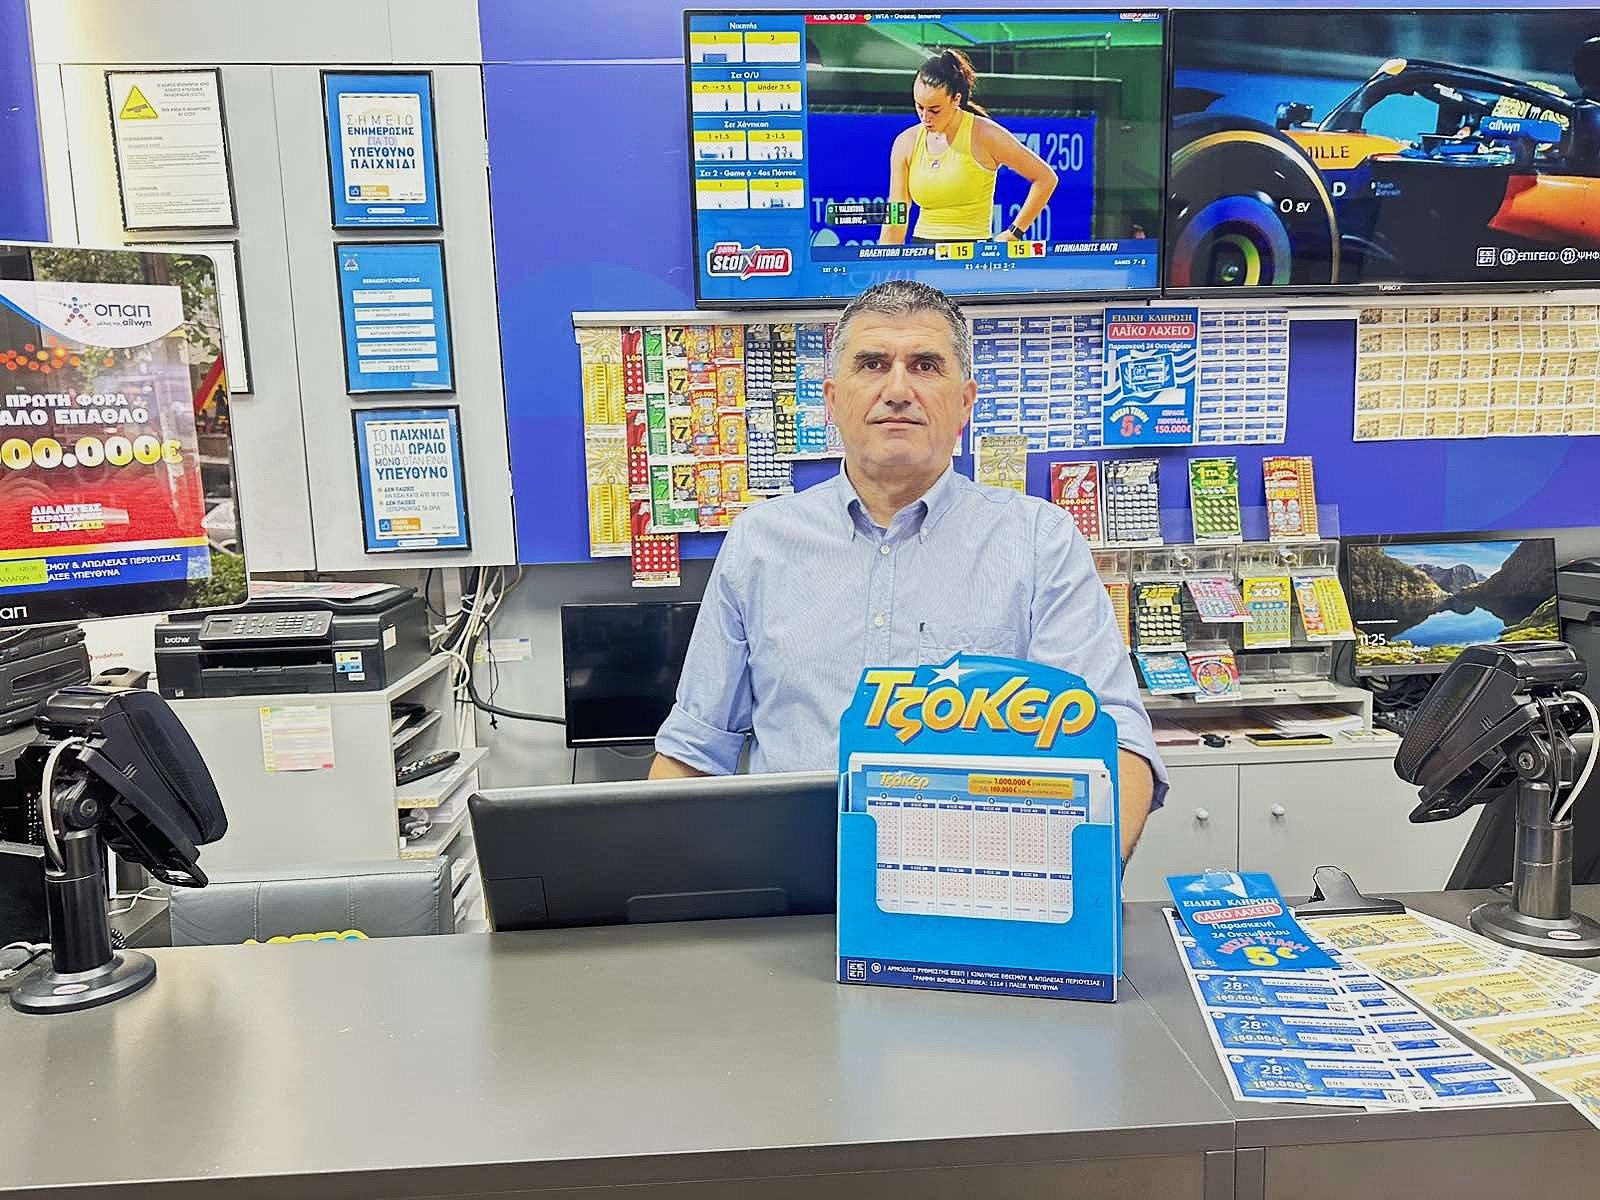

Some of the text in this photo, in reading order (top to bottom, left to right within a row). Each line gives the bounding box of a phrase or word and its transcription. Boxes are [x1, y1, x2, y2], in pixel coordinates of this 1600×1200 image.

[346, 114, 414, 126] ΣΗΜΕΙΟ
[347, 127, 415, 136] ΕΝΗΜΕΡΩΣΗΣ
[1488, 121, 1520, 134] allwyn
[349, 147, 415, 158] ΥΠΕΥΘΥΝΟ
[1045, 133, 1084, 171] 250
[351, 159, 416, 169] ΠΑΙΧΝΙΔΙ
[1332, 182, 1347, 197] D
[1296, 202, 1310, 213] εν
[956, 245, 968, 256] 15
[1014, 244, 1025, 255] 15
[94, 304, 151, 318] οπαπ
[122, 319, 152, 328] allwyn
[1112, 314, 1192, 322] ΕΙΔΙΚΗ ΚΛΗΡΩΣΗ
[1111, 324, 1190, 337] ΛΑΪΚΟ ΛΑΧΕΙΟ
[673, 378, 686, 391] 7
[5, 393, 129, 408] ΠΡΩΤΗ ΦΟΡΑ
[54, 408, 149, 425] ΕΠΑΘΛΟ
[372, 428, 444, 441] ΤΟ ΠΑΙΧΝΙΔΙ
[675, 426, 688, 440] 7
[0, 434, 184, 471] 00.000€
[373, 442, 446, 456] ΕΙΝΑΙ ΩΡΑΙΟ
[375, 457, 400, 466] ΜΟΝΟ
[376, 466, 448, 480] ΥΠΕΥΘΥΝΟ
[678, 474, 690, 487] 7
[81, 557, 128, 569] ΑΠΩΛΕΙΑΣ
[129, 553, 182, 565] ΠΕΡΙΟΥΣΙΑΣ
[48, 569, 121, 582] ΑΙΞΕ ΥΠΕΥΘΥΝΑ
[164, 636, 190, 644] brother
[993, 777, 1026, 786] 1.000.000
[1183, 897, 1280, 908] ΕΙΔΙΚΗ ΚΛΗΡΩΣΗ
[1234, 906, 1277, 919] ΛΑΧΕΙΟ
[1211, 920, 1277, 931] Παρασκευή
[887, 965, 916, 973] ΑΡΜΟΔΙΟΣ
[917, 967, 949, 975] ΡΥΘΜΙΣΤΗΣ
[971, 971, 1000, 979] ΚΙΝΔΥΝΟΣ
[1034, 976, 1064, 984] ΑΠΩΛΕΙΑΣ
[1065, 978, 1101, 986] ΠΕΡΙΟΥΣΙΑΣ
[1027, 983, 1059, 991] ΥΠΕΥΘΥΝΑ
